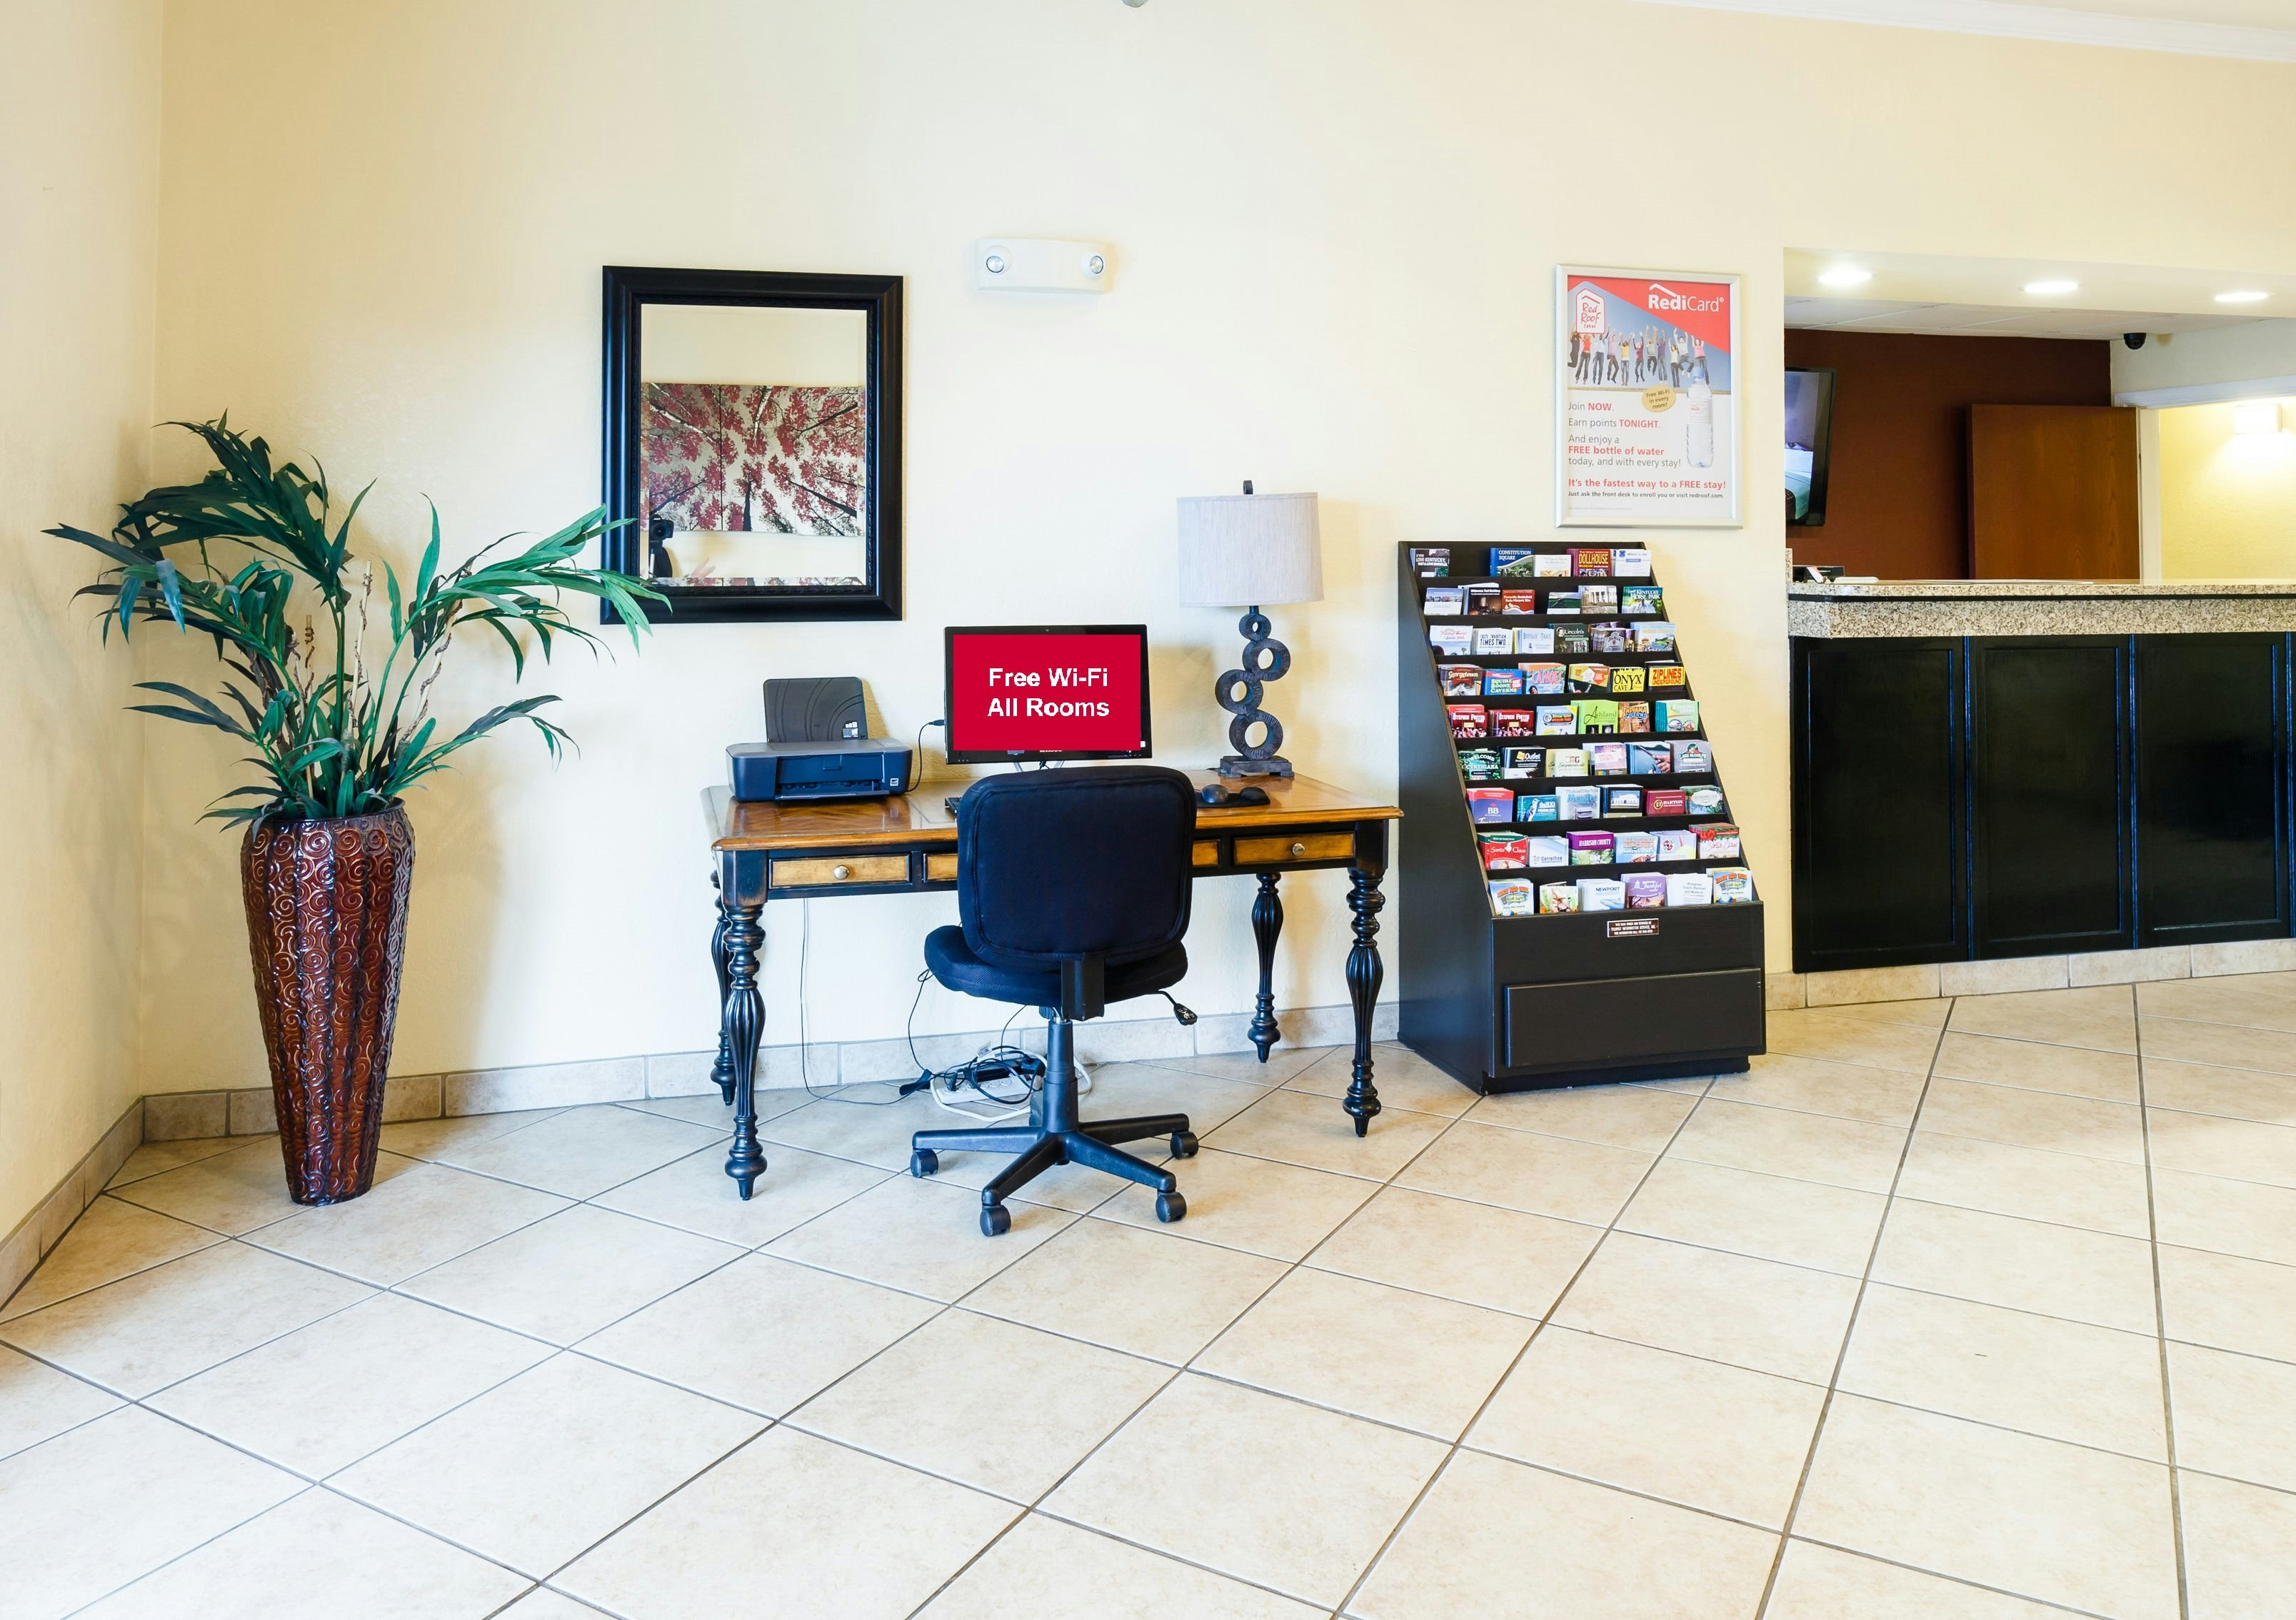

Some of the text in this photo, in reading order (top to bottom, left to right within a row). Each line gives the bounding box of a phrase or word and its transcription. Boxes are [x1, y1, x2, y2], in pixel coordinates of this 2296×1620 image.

[1582, 303, 1598, 313] Red
[1580, 312, 1601, 324] Roof
[1568, 402, 1614, 411] Join NOW.
[1568, 418, 1661, 428] Earn points TONIGHT.
[1568, 434, 1585, 443] And
[1588, 435, 1612, 445] enjoy
[1568, 446, 1665, 456] FREE bottle of water
[1568, 457, 1681, 468] today, and with every stay!
[1603, 478, 1635, 487] fastest
[1638, 481, 1656, 490] way
[1703, 481, 1726, 490] stay!
[1579, 553, 1609, 564] DOLLHOUSE
[989, 668, 1108, 687] Free Wi-Fi
[1653, 668, 1682, 680] ZIPLINES
[1614, 674, 1643, 690] ONYX
[988, 698, 1109, 717] All Rooms
